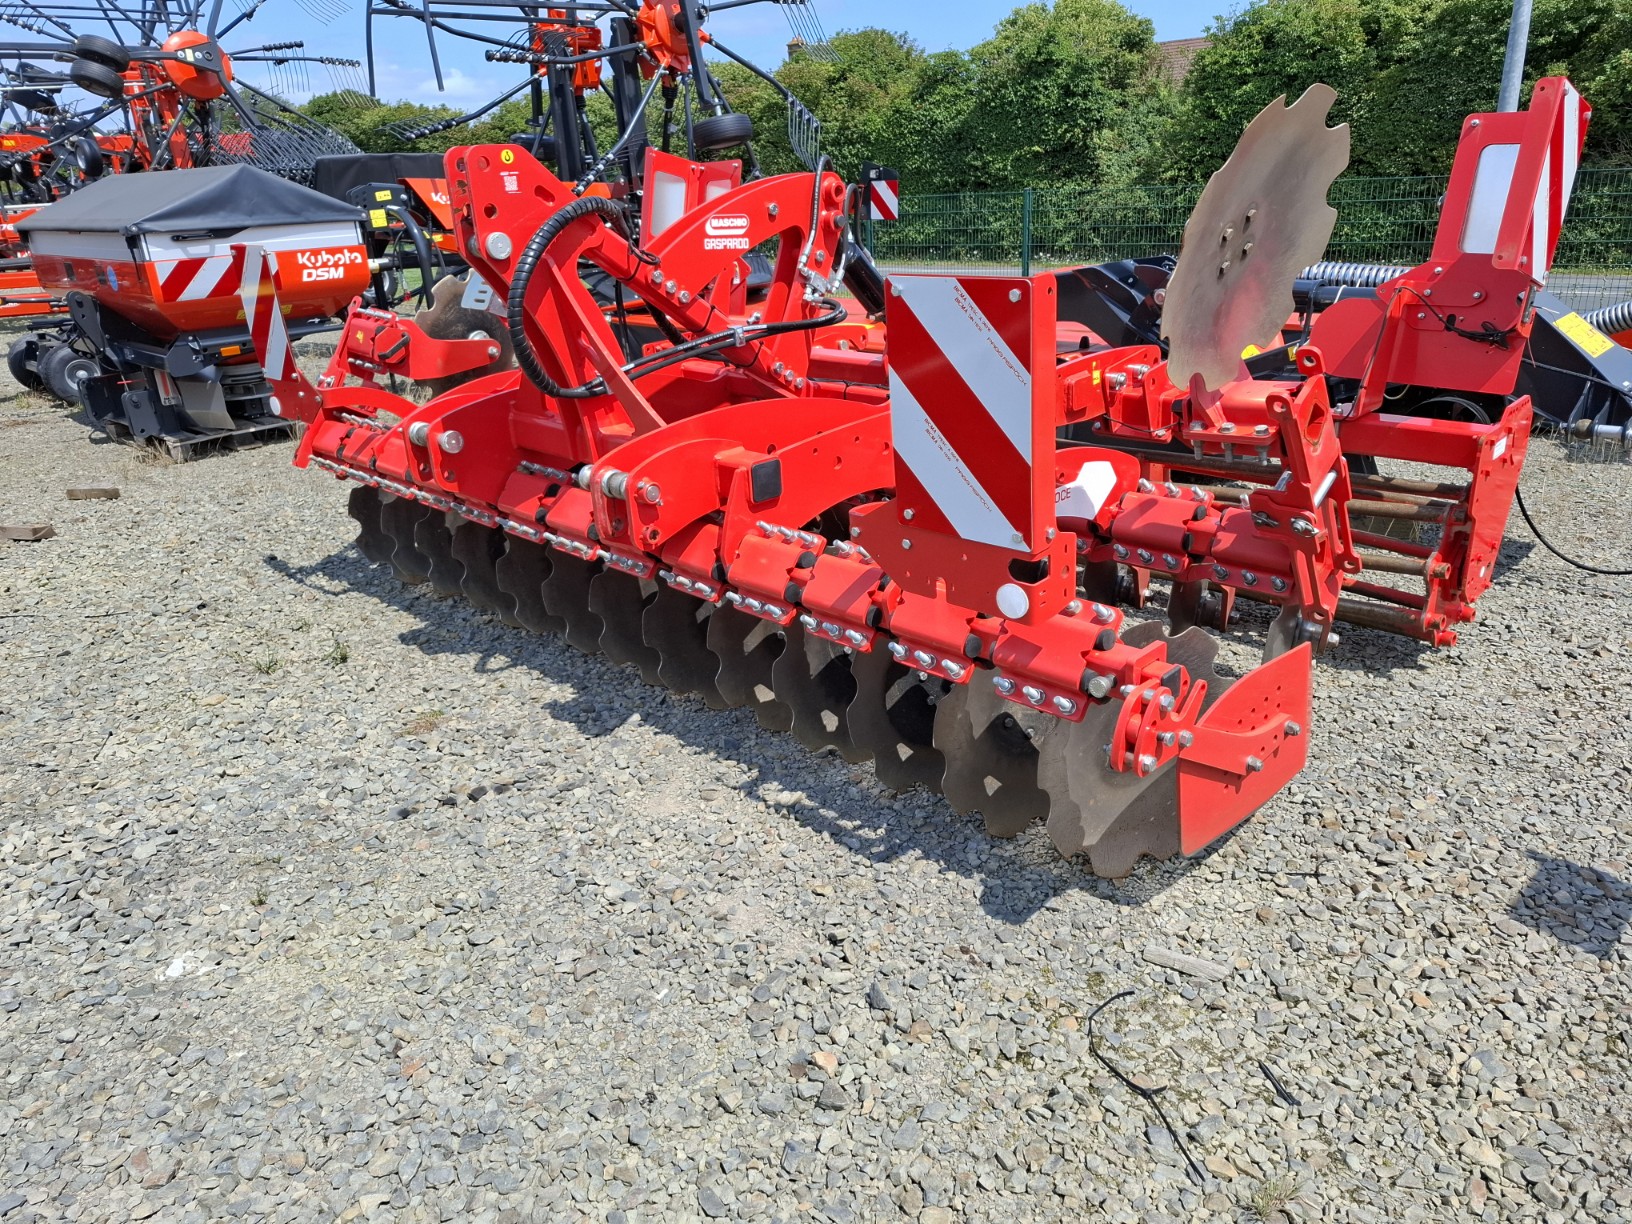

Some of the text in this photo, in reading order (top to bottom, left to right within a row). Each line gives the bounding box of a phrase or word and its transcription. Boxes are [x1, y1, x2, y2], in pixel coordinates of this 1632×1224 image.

[711, 218, 748, 227] MASCHIO
[704, 237, 749, 250] GASPARDO
[297, 248, 363, 267] Kubota
[302, 266, 344, 282] DSM
